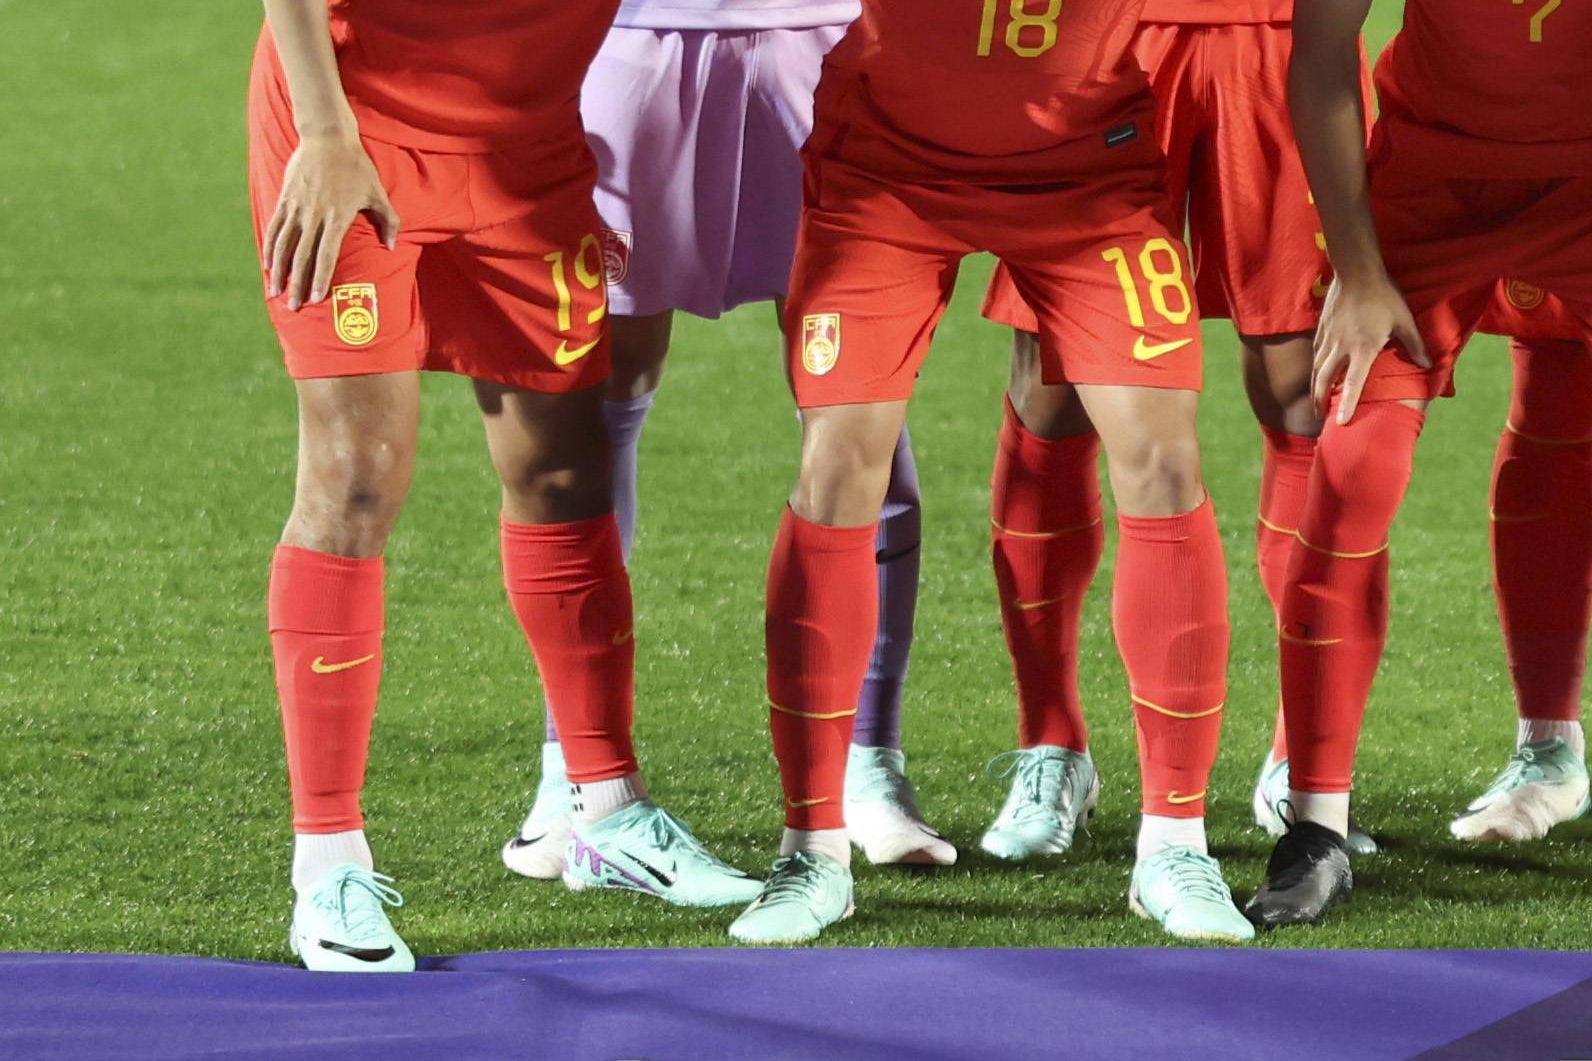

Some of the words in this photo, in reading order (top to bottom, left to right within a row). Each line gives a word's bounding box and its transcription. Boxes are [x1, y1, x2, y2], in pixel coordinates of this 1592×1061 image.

[337, 287, 372, 300] CFA
[543, 233, 607, 332] 19
[1101, 237, 1192, 327] 18
